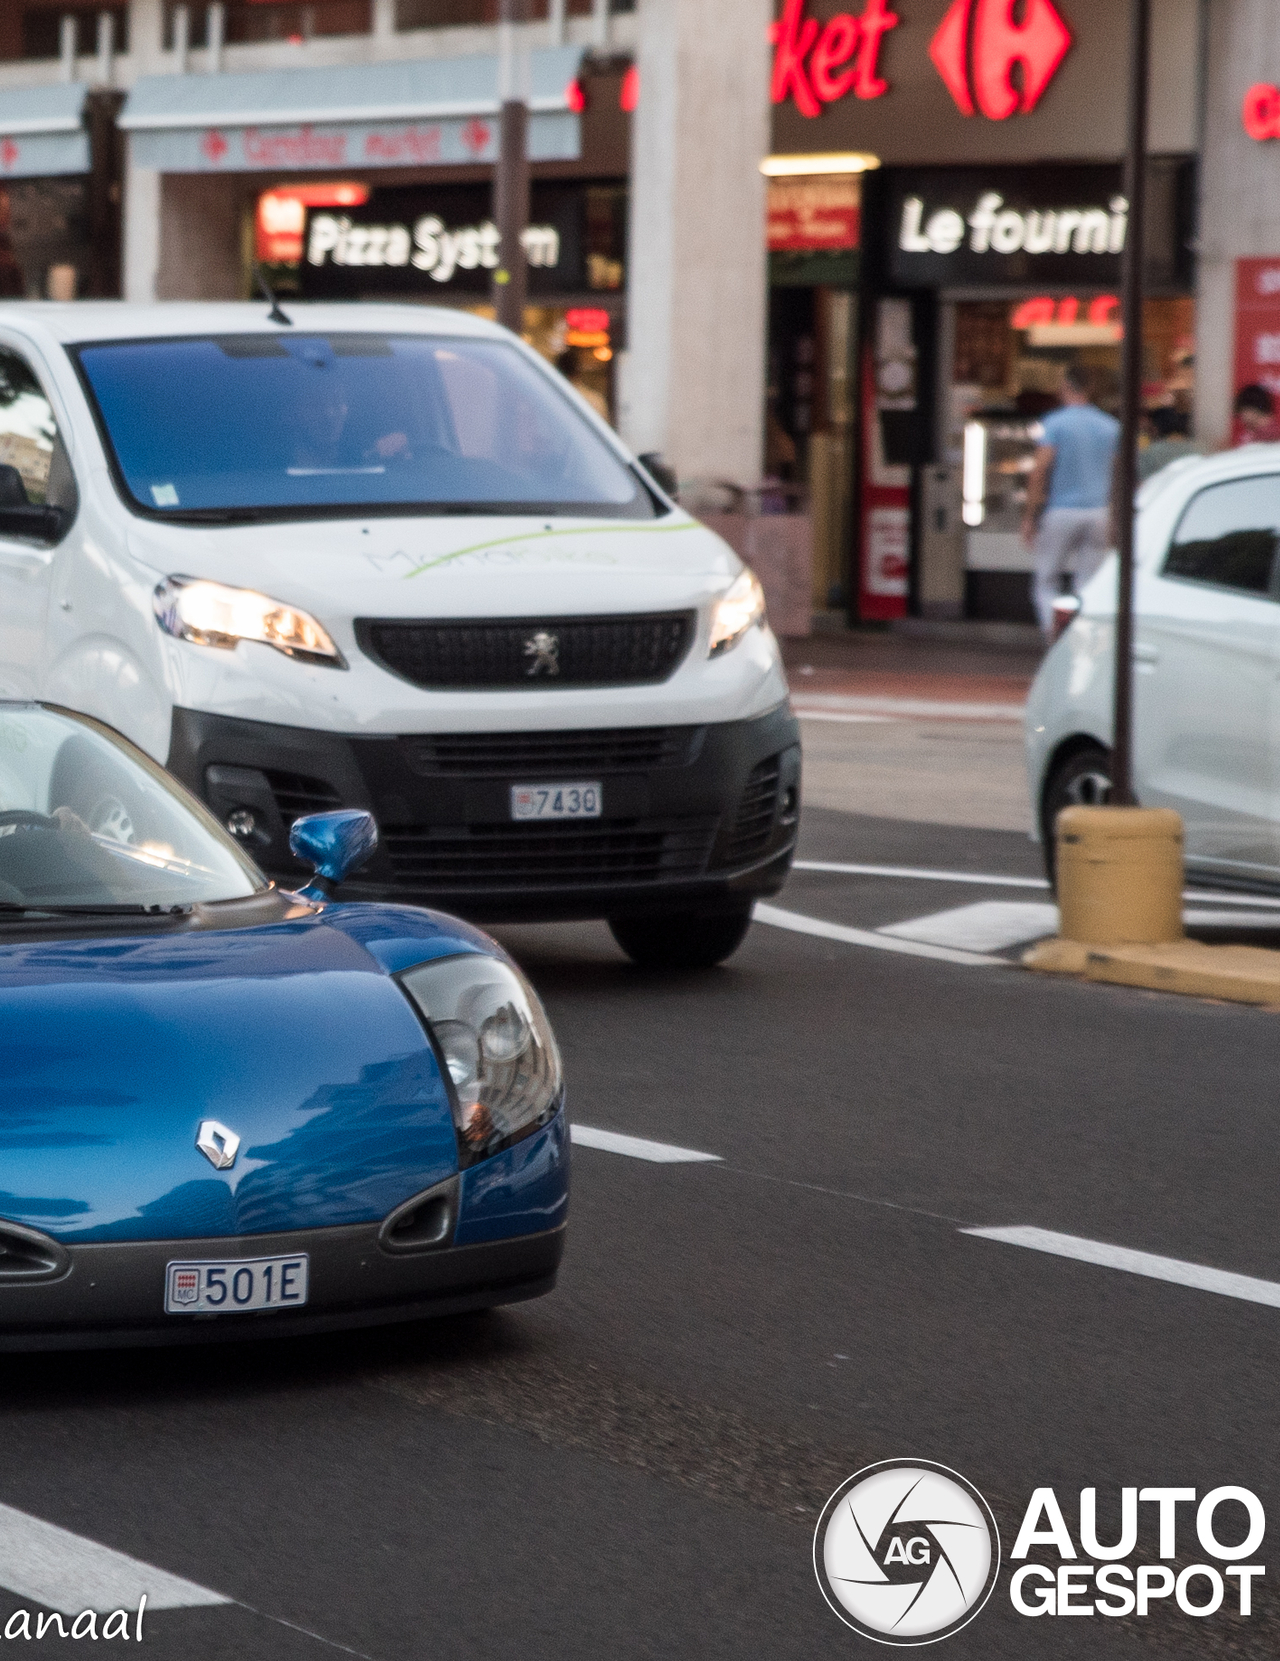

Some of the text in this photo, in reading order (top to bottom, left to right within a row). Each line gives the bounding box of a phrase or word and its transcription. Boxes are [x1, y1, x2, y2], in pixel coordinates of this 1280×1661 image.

[767, 0, 898, 118] ket
[308, 214, 410, 266] Pizza
[410, 214, 561, 281] Systm
[898, 196, 965, 254] Le
[967, 191, 1130, 254] fourni
[537, 789, 596, 814] 7430
[177, 1289, 194, 1300] MC
[205, 1262, 302, 1306] 501E
